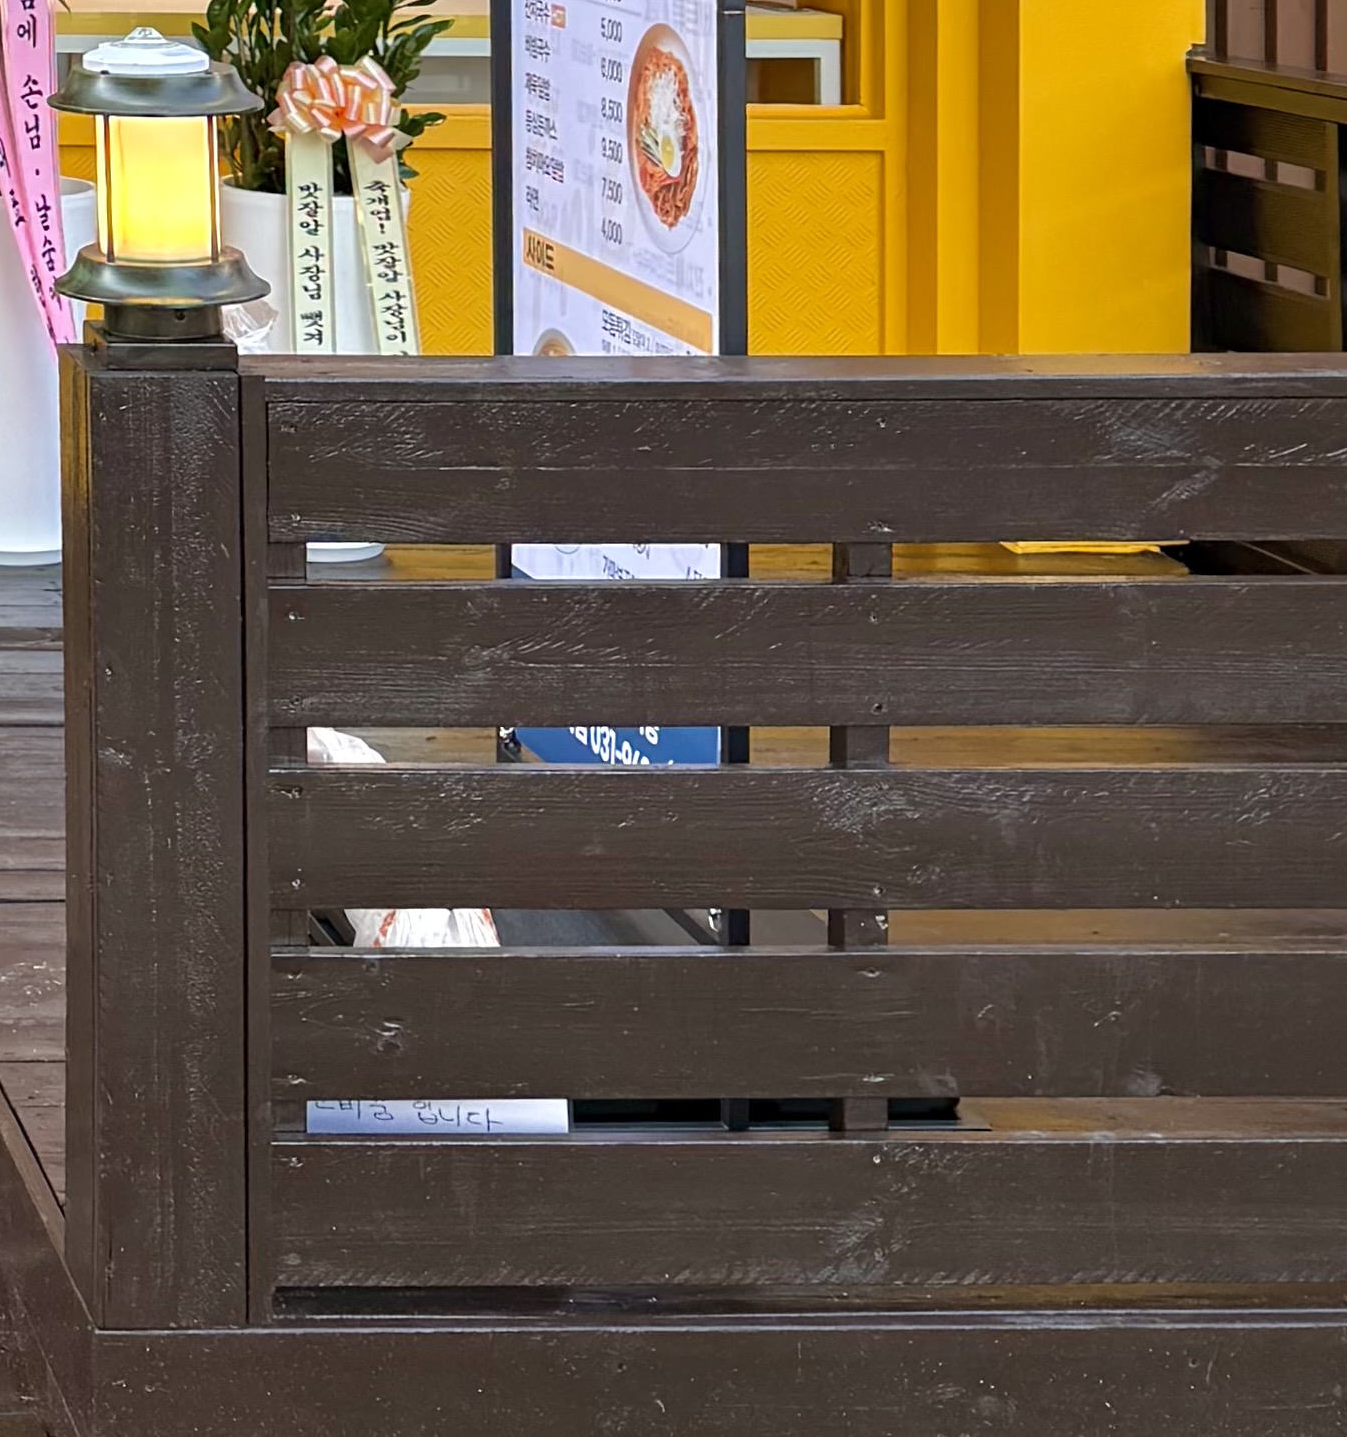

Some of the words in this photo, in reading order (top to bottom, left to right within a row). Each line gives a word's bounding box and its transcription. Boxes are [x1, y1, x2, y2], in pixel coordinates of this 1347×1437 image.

[297, 181, 324, 236] 맛잘알
[298, 245, 324, 301] 사장님
[526, 233, 555, 271] 사이드
